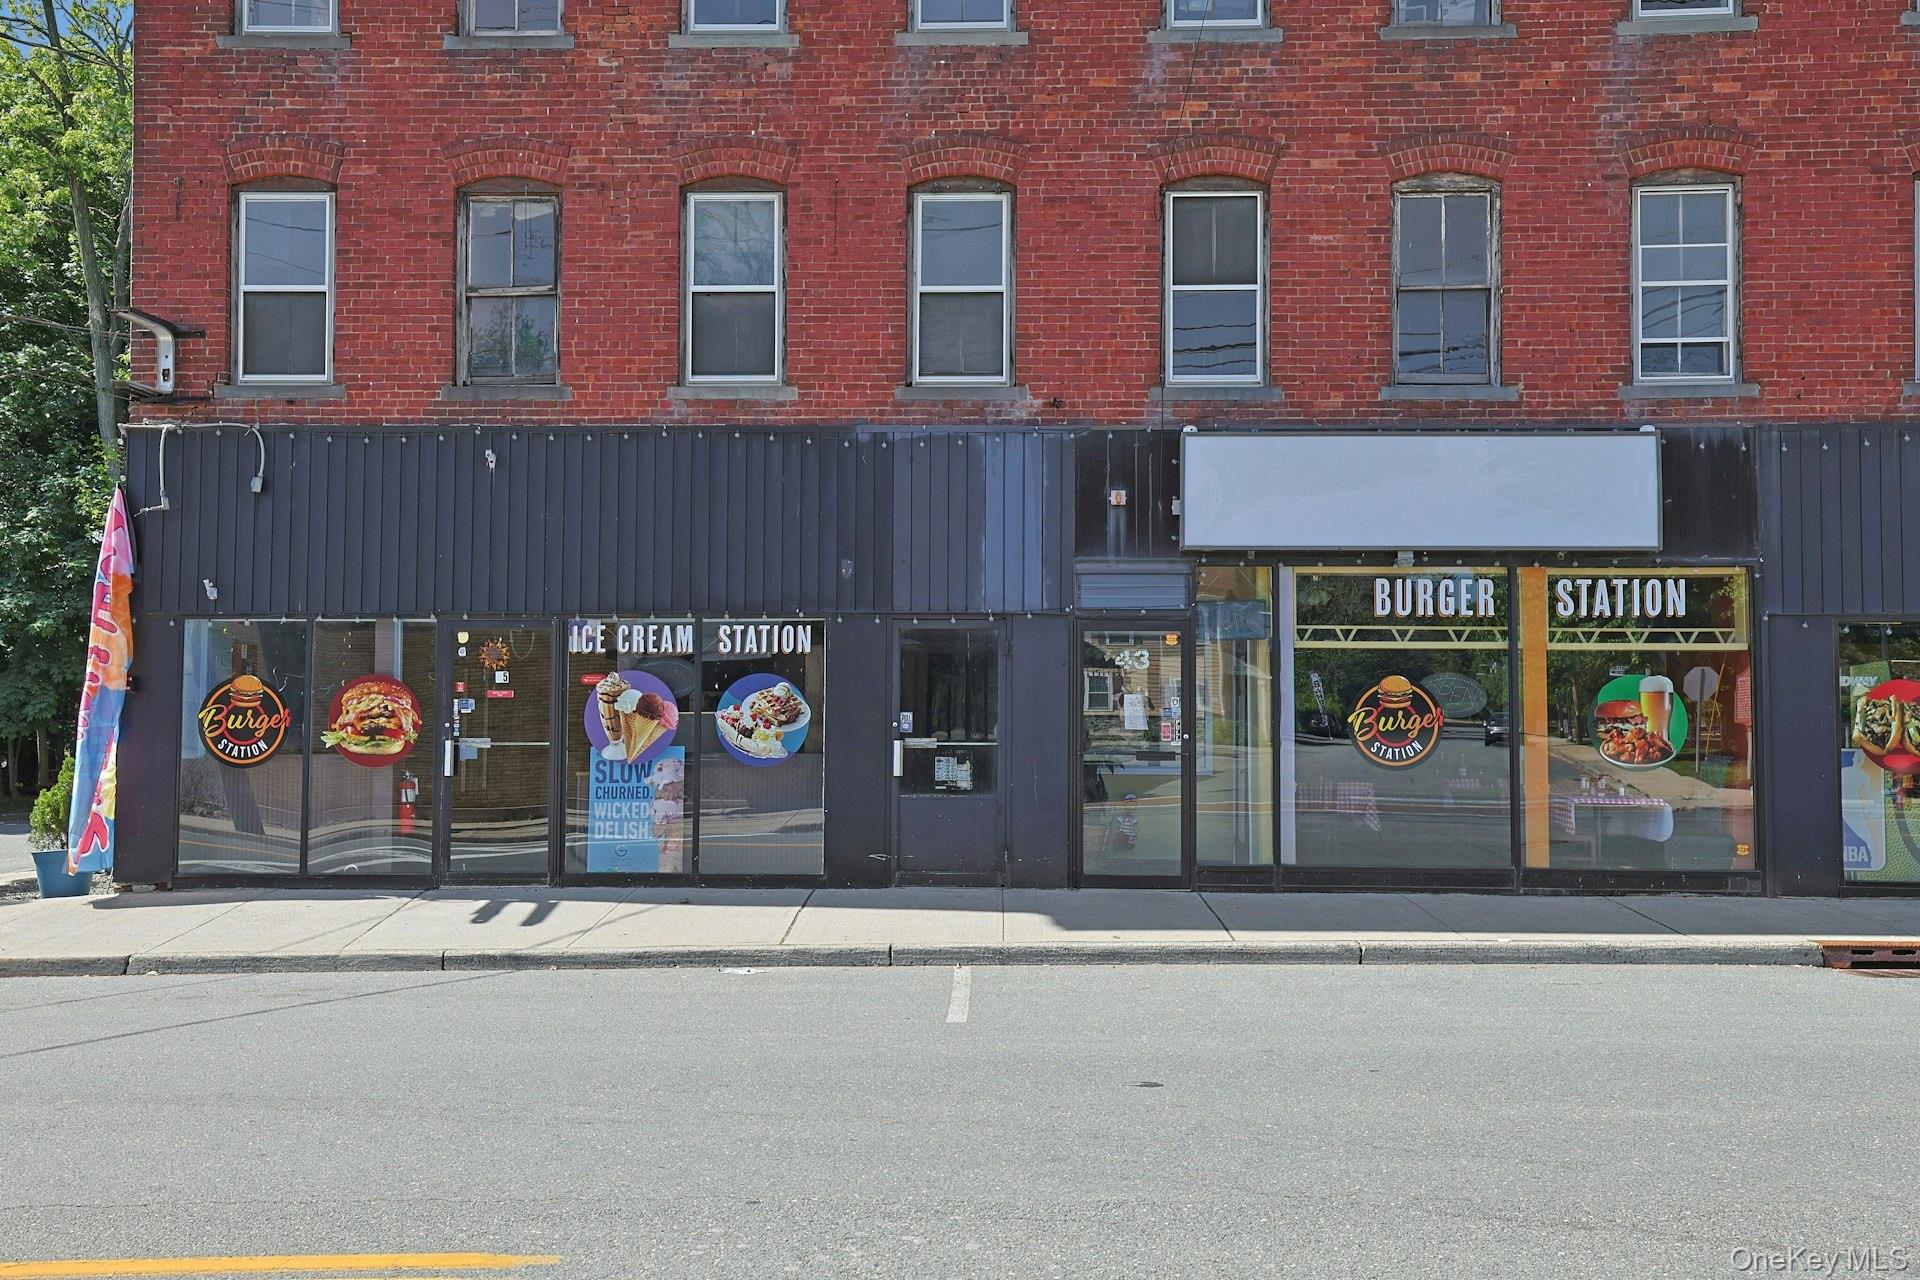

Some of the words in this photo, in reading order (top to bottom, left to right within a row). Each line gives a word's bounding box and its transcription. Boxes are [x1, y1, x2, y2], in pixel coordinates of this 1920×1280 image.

[1374, 577, 1496, 617] BURGER
[1556, 578, 1687, 617] STATION
[571, 624, 606, 654] ICE
[617, 624, 694, 653] CREAM
[718, 624, 812, 654] STATION
[1115, 650, 1150, 669] 43
[502, 672, 508, 682] 5
[197, 704, 292, 738] Burger
[1347, 706, 1445, 742] Burger
[217, 739, 268, 758] STATION
[1370, 741, 1423, 760] STATION
[595, 760, 653, 783] SLOW
[596, 786, 653, 799] CHURNED.
